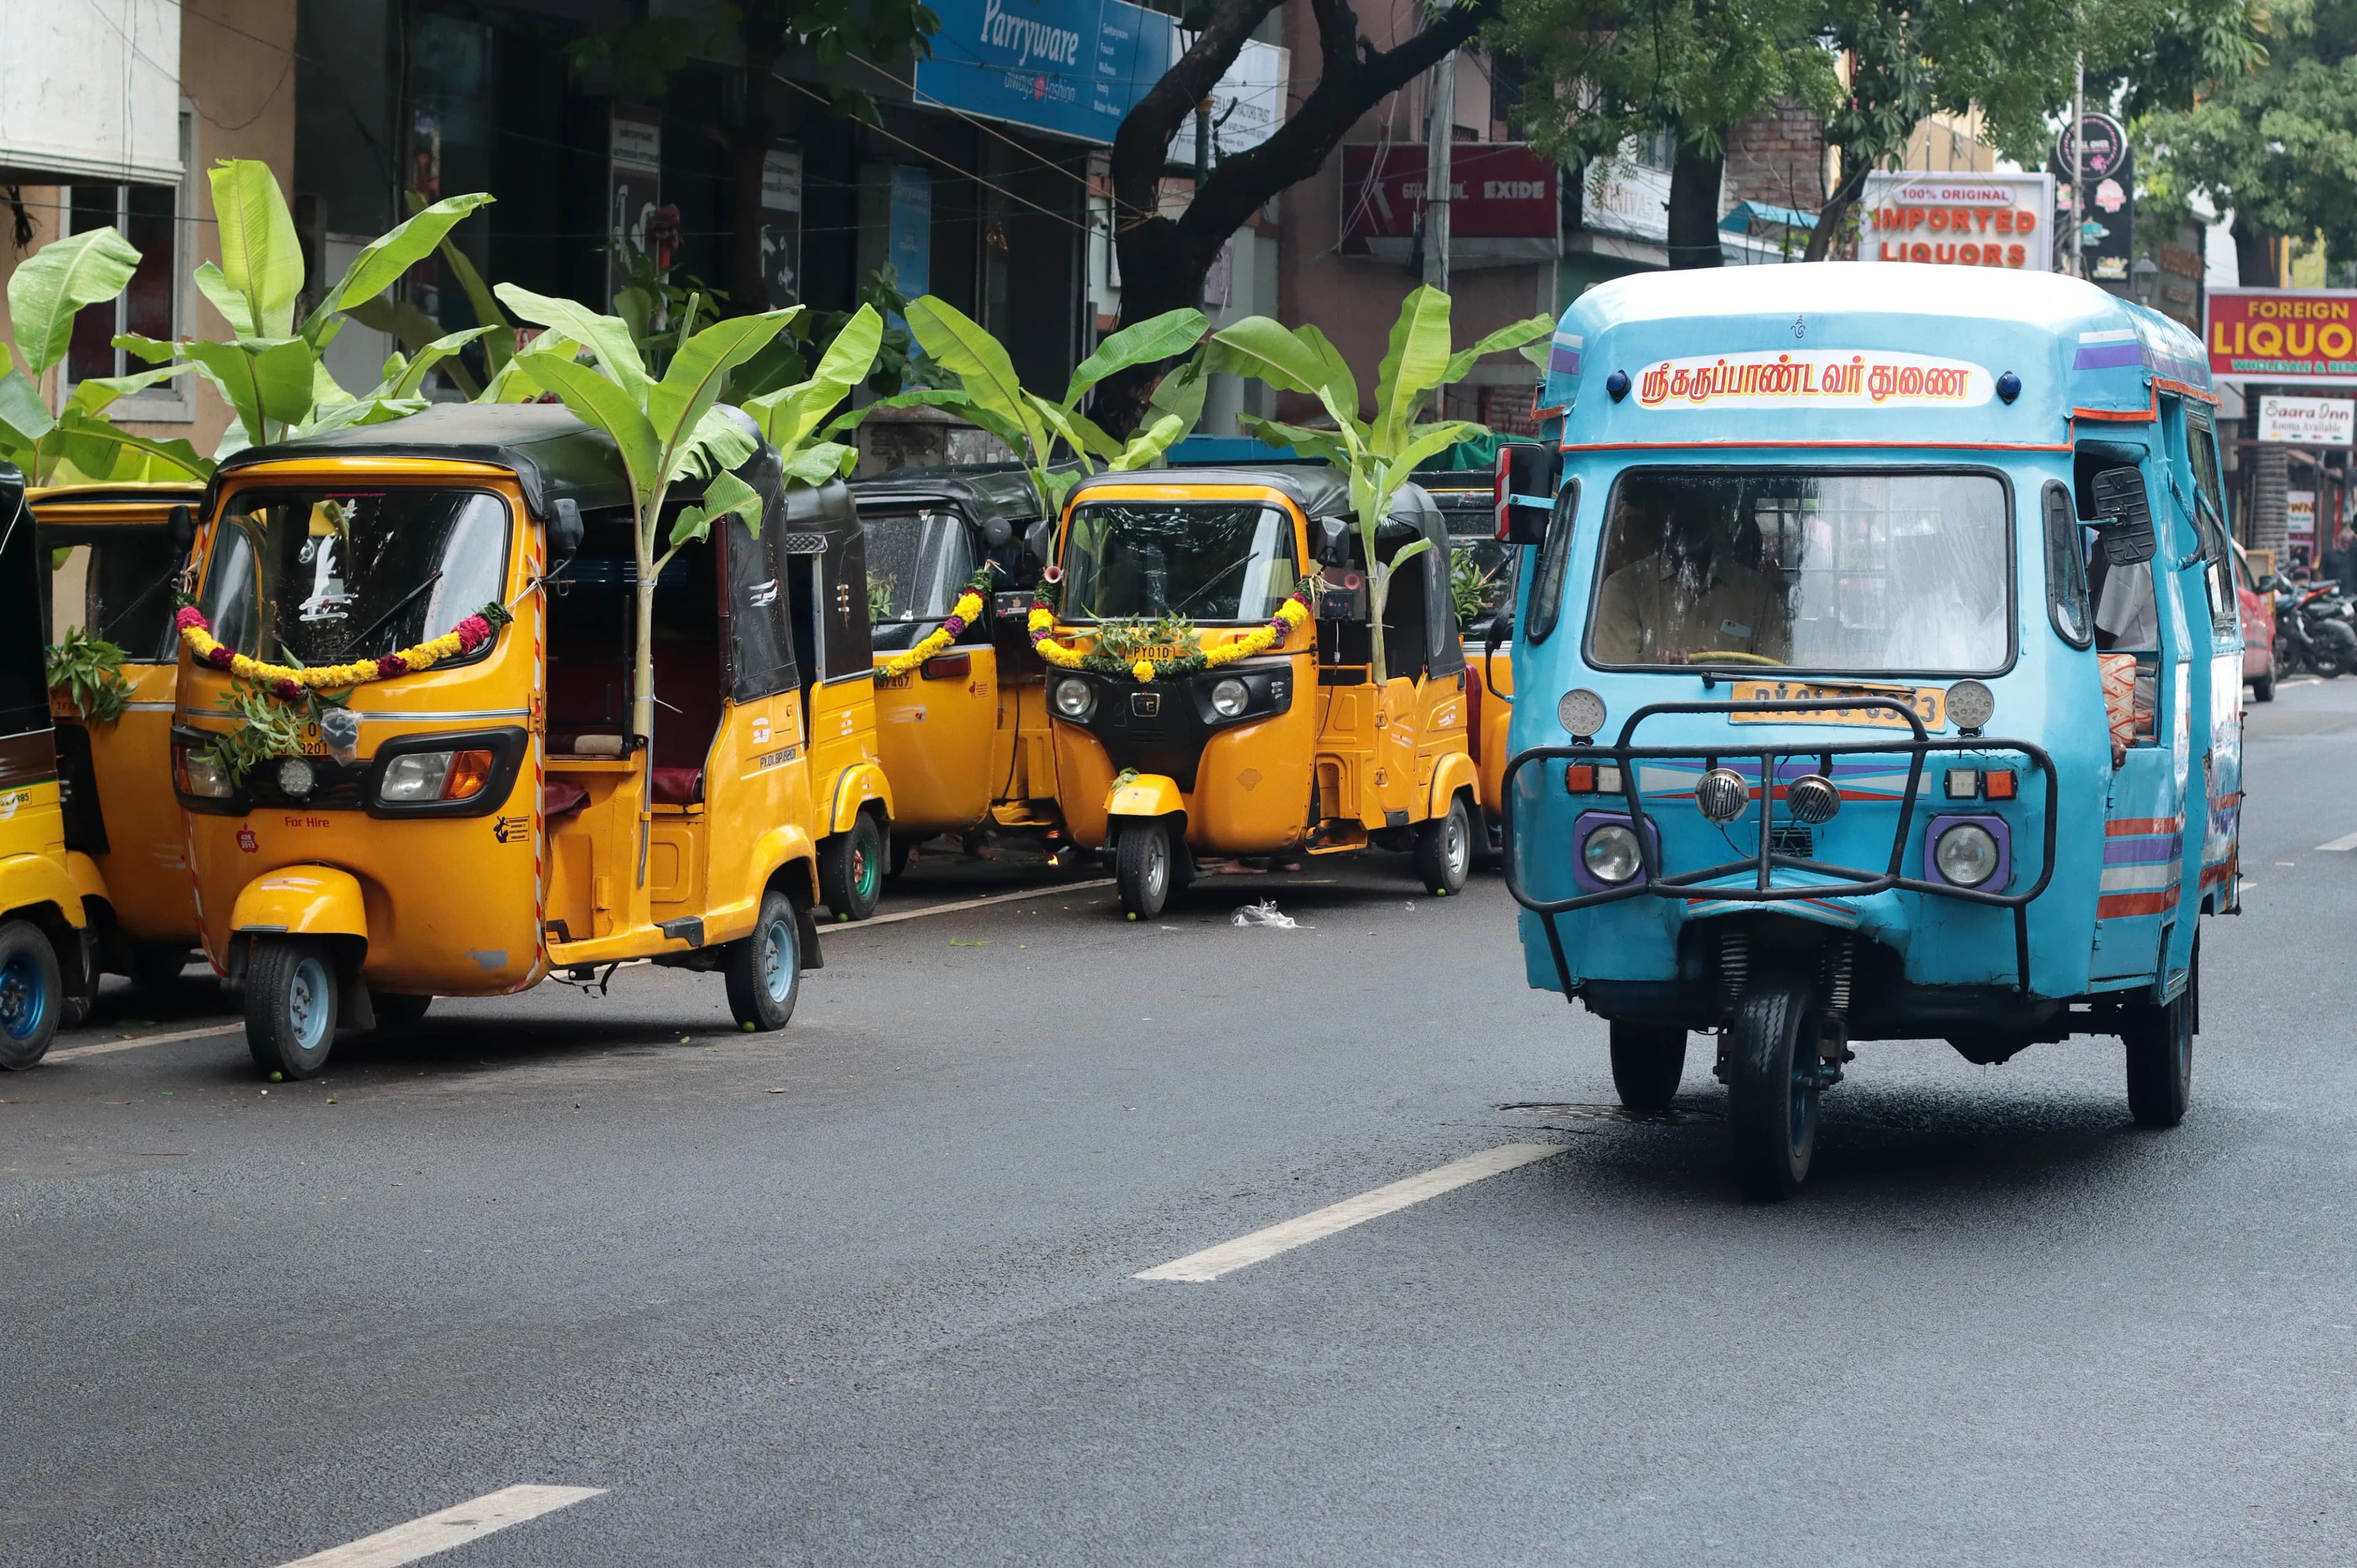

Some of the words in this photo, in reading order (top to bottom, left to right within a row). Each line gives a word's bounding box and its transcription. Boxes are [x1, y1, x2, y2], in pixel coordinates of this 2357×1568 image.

[980, 0, 1079, 66] Parryware
[1044, 74, 1076, 104] fashion
[1484, 180, 1545, 199] EXIDE
[1902, 188, 1937, 200] 100%
[1942, 189, 2009, 201] ORIGINAL
[1872, 207, 2036, 232] IMPORTED
[1880, 241, 2026, 266] LIQUORS
[2248, 301, 2350, 320] FOREIGN
[2213, 321, 2357, 358] LIQUO
[2231, 359, 2312, 373] WHOLESALE
[2315, 360, 2327, 373] &
[1868, 363, 1972, 403] துணை
[2265, 400, 2316, 419] Saara
[2318, 403, 2349, 420] Inn
[2303, 422, 2342, 433] Available
[1134, 646, 1169, 658] PY01D
[284, 816, 303, 827] For
[306, 817, 330, 828] Hire
